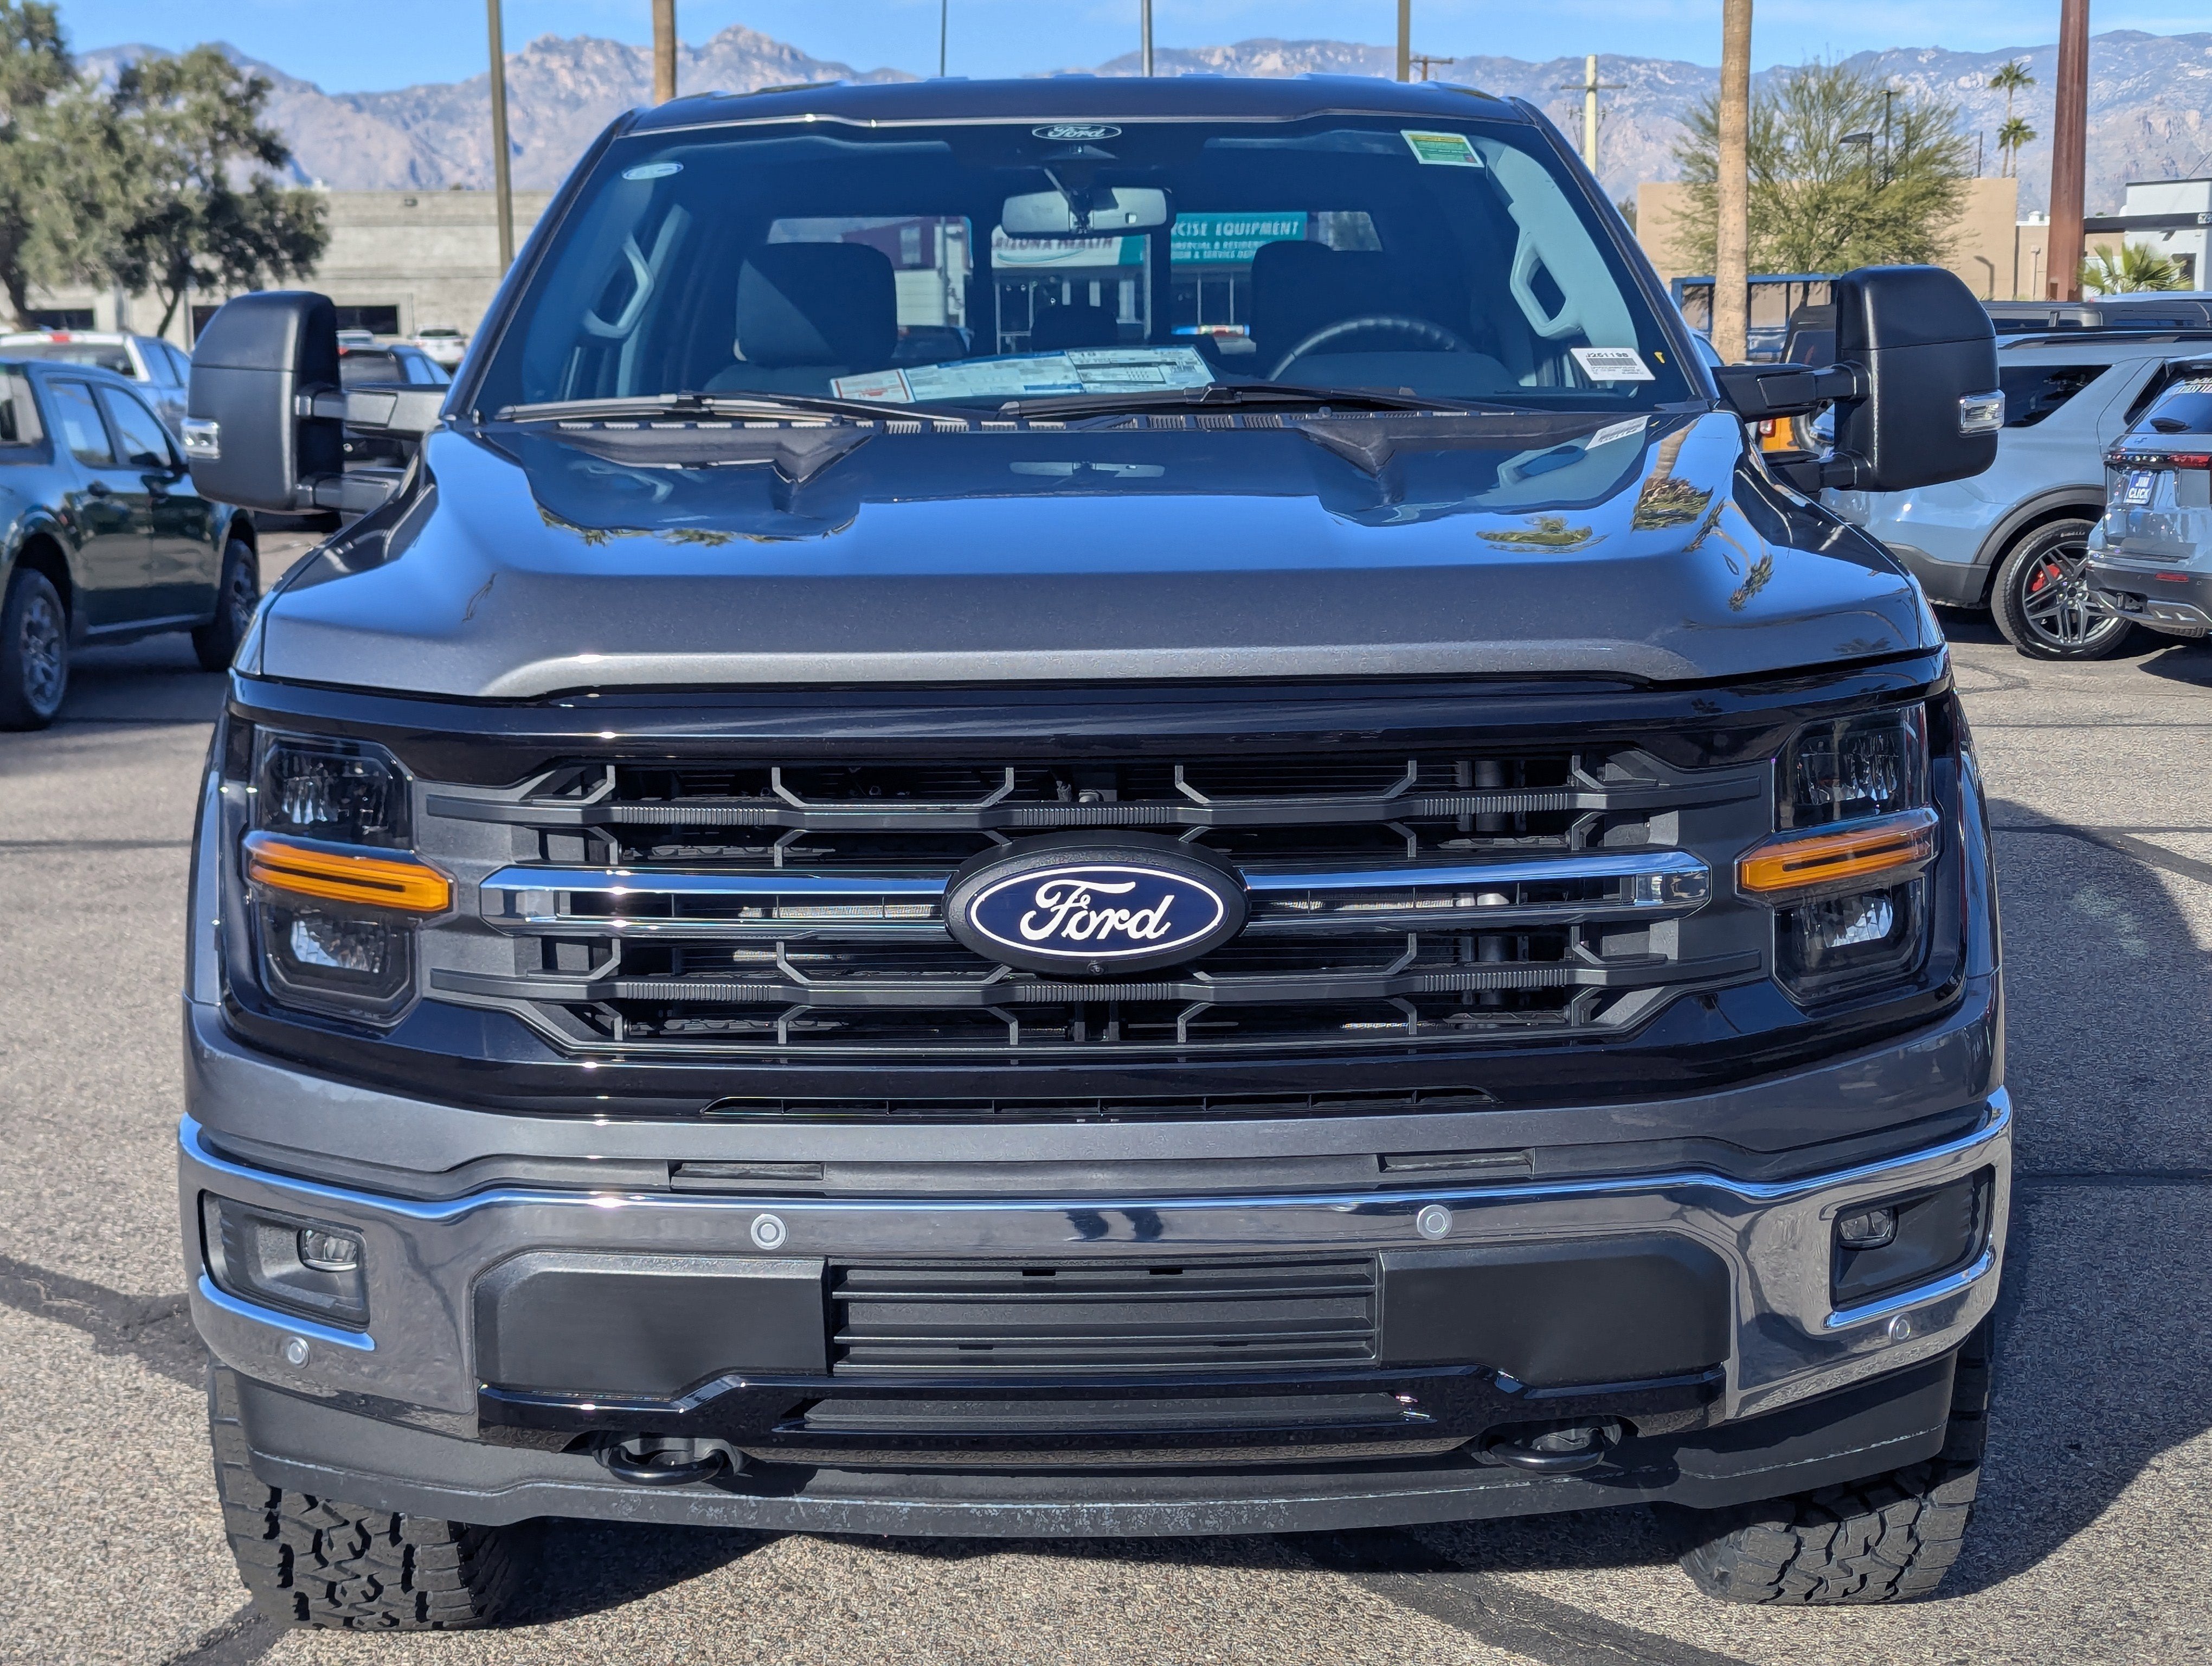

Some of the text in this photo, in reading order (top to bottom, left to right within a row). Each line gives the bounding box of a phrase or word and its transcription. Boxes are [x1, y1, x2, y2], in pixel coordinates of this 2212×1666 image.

[1047, 125, 1106, 137] Ford
[1216, 221, 1299, 236] EQUIPMENT
[1020, 879, 1175, 941] Ford
